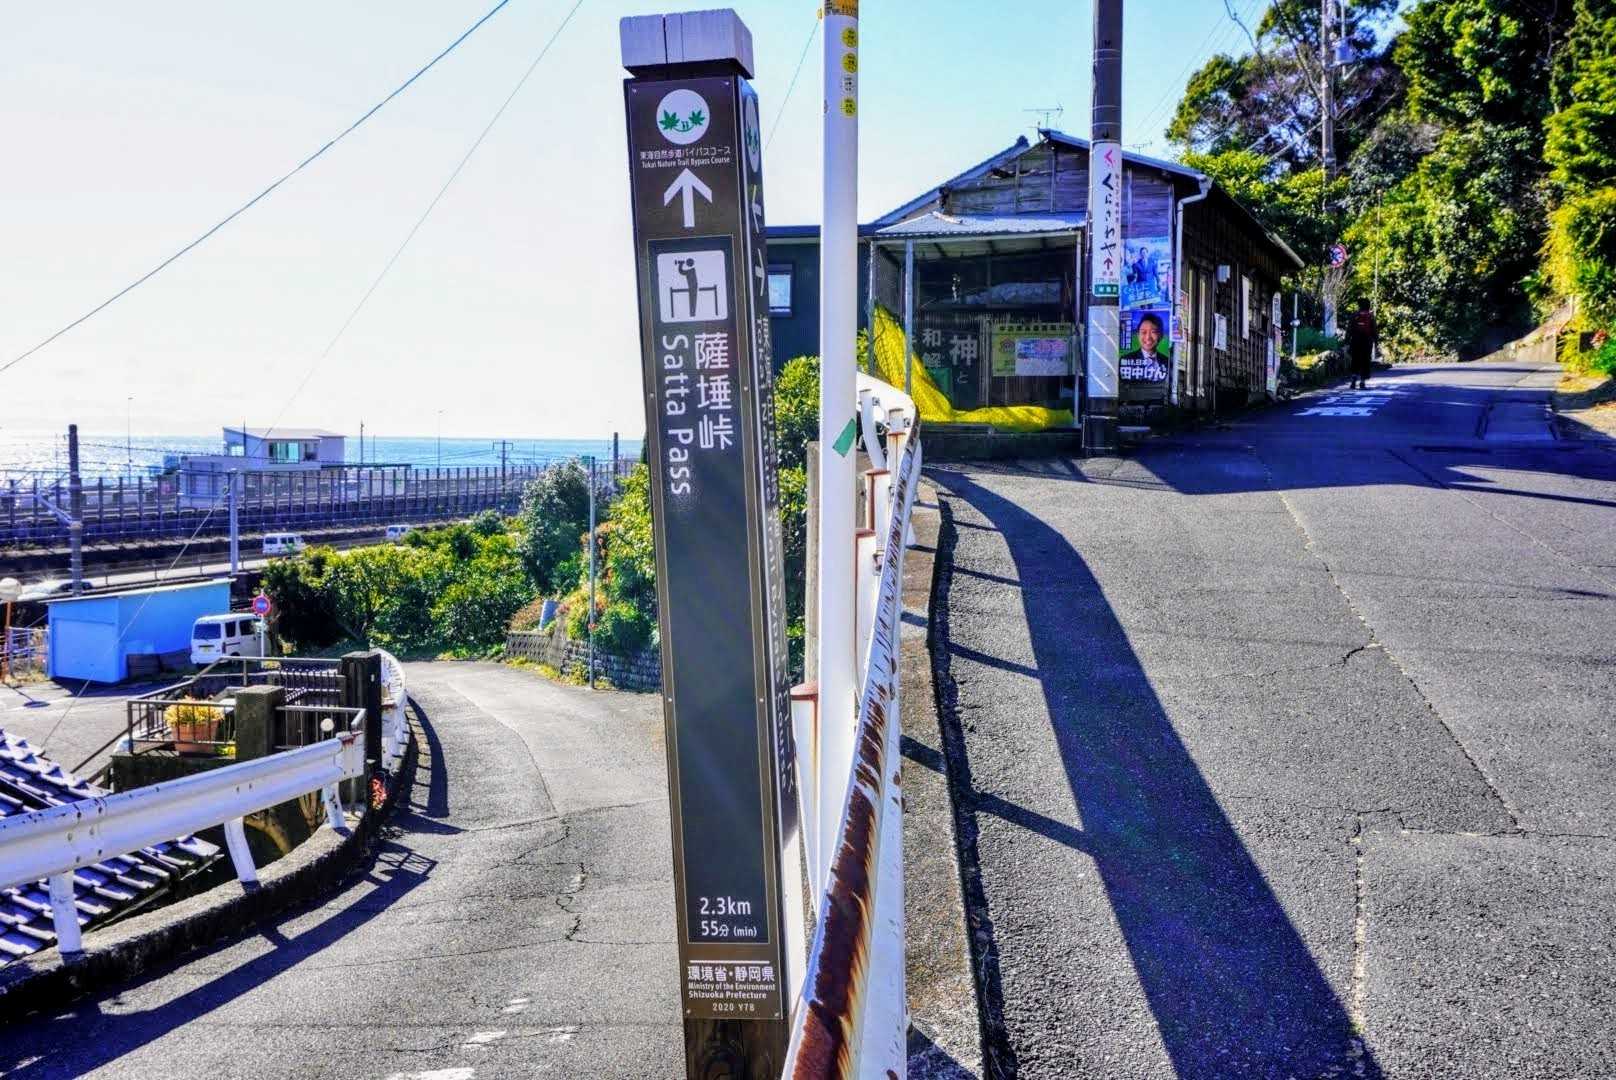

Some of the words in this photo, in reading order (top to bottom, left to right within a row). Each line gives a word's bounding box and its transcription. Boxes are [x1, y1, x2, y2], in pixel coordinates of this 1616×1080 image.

[711, 156, 730, 164] Course
[662, 334, 689, 416] Satta
[668, 428, 692, 496] Pass
[700, 896, 751, 915] 2.3km
[733, 926, 757, 937] (min)
[688, 982, 714, 992] Ministry
[715, 982, 722, 991] of
[723, 983, 733, 991] the
[735, 983, 776, 991] Environment
[688, 991, 724, 999] Shizuoka
[726, 991, 767, 999] Prefecture
[712, 1003, 734, 1011] 2020
